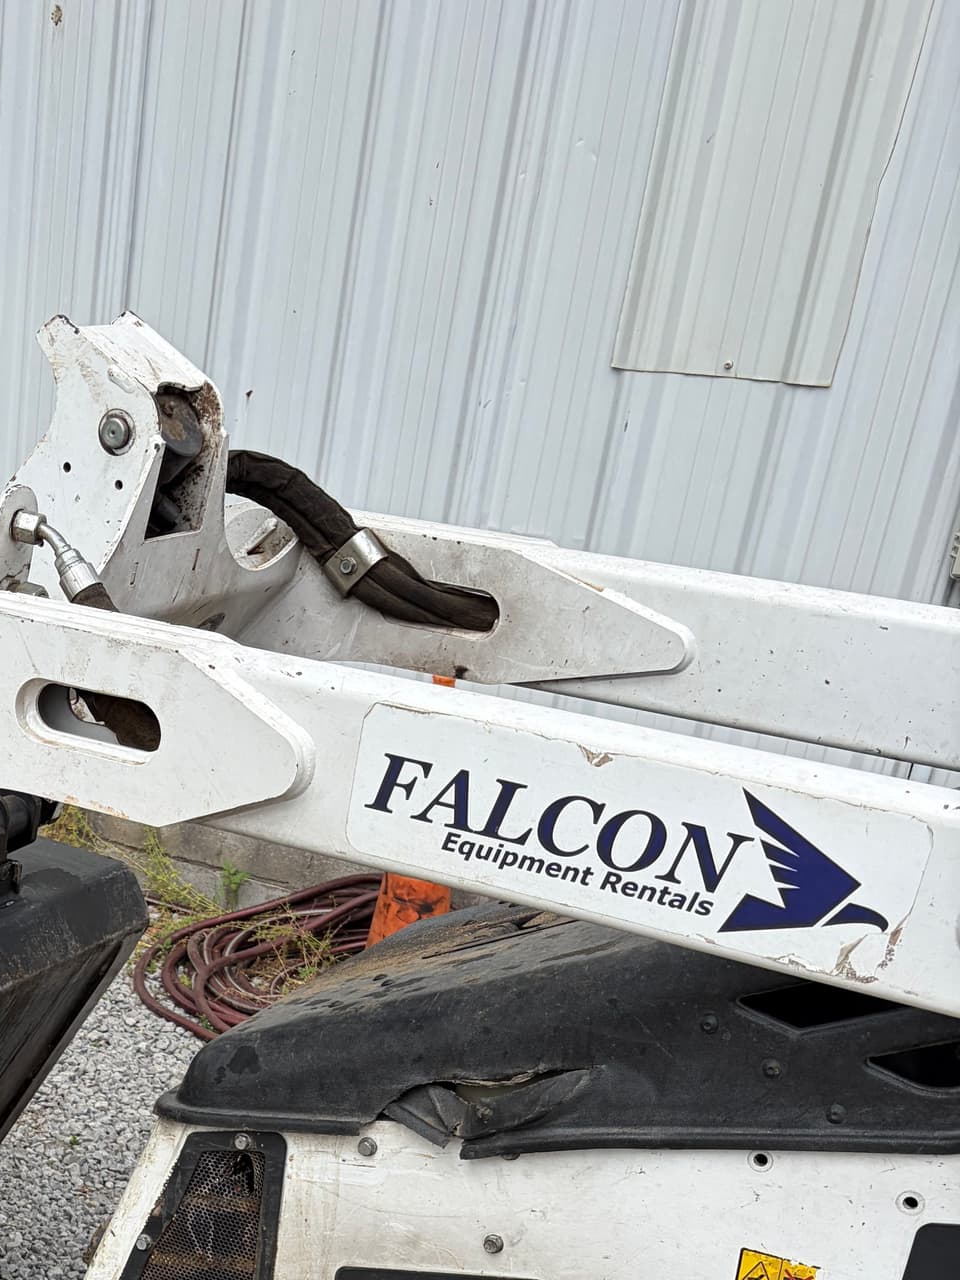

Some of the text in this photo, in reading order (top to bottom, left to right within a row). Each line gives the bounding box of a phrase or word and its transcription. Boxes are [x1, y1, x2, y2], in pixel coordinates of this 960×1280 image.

[364, 753, 754, 893] FALCON
[440, 833, 714, 917] Equipment Rentals
